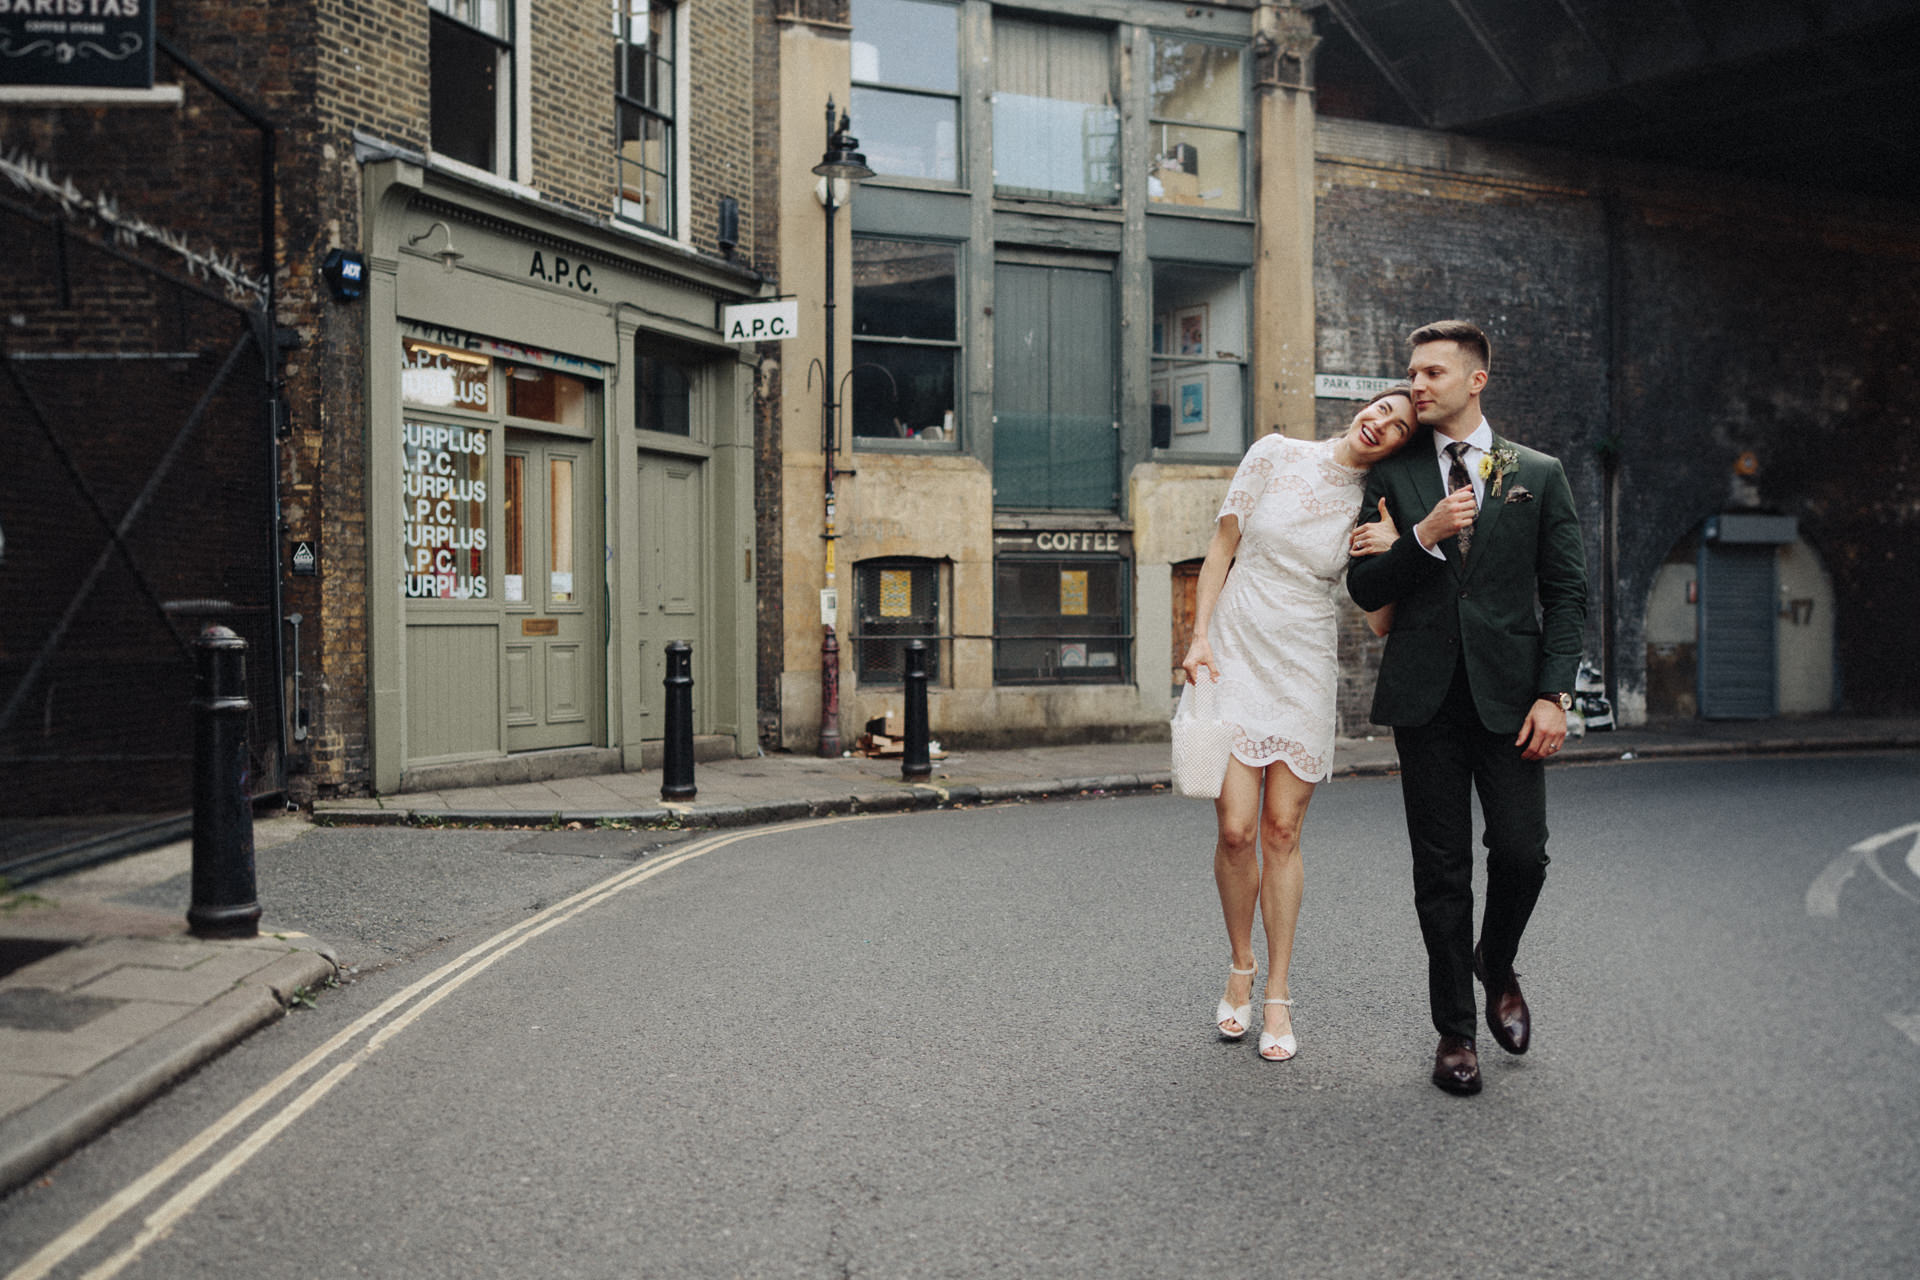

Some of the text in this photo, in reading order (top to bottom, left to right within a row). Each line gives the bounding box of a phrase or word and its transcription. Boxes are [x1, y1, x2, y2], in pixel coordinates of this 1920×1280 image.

[342, 263, 362, 279] ADT
[530, 251, 598, 294] A.P.C.
[731, 317, 790, 338] A.P.C.
[1322, 377, 1389, 392] PARK STREET
[403, 473, 486, 503] URPLUS
[404, 523, 487, 551] URPLUS
[1037, 533, 1120, 550] COFFEE
[405, 573, 488, 598] URPLUS
